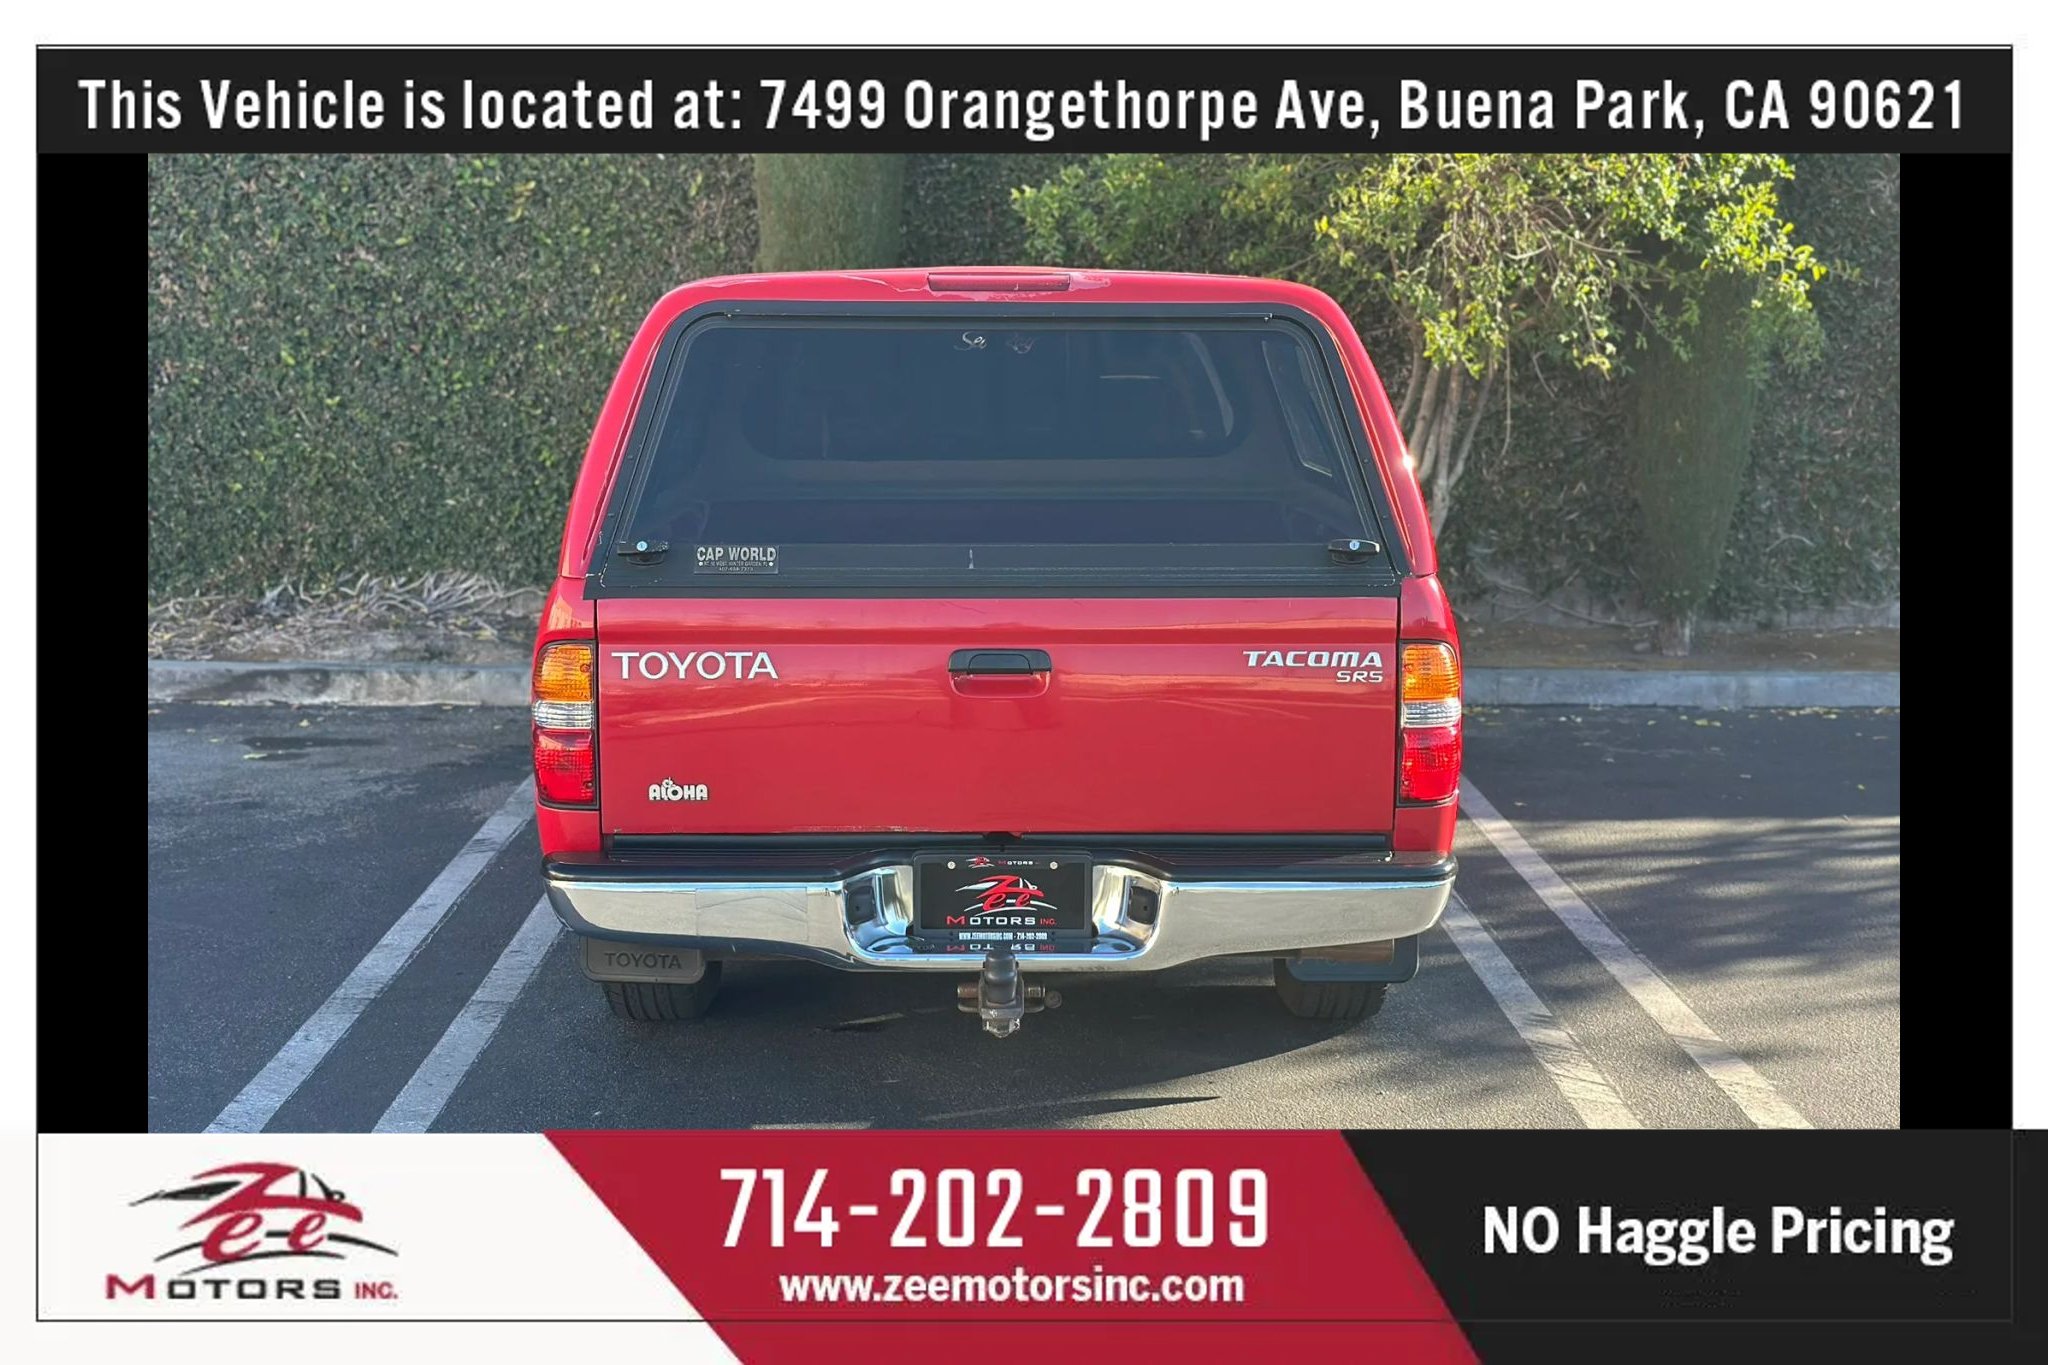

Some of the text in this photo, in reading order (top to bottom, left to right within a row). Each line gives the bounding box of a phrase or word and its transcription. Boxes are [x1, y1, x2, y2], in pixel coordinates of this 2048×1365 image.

[696, 546, 777, 561] CAP WORLD
[611, 651, 779, 680] TOYOTA
[1242, 650, 1383, 668] TACOMA
[648, 777, 709, 801] ALOHA
[946, 915, 1036, 926] MOTORS
[604, 952, 683, 970] TOYOTA
